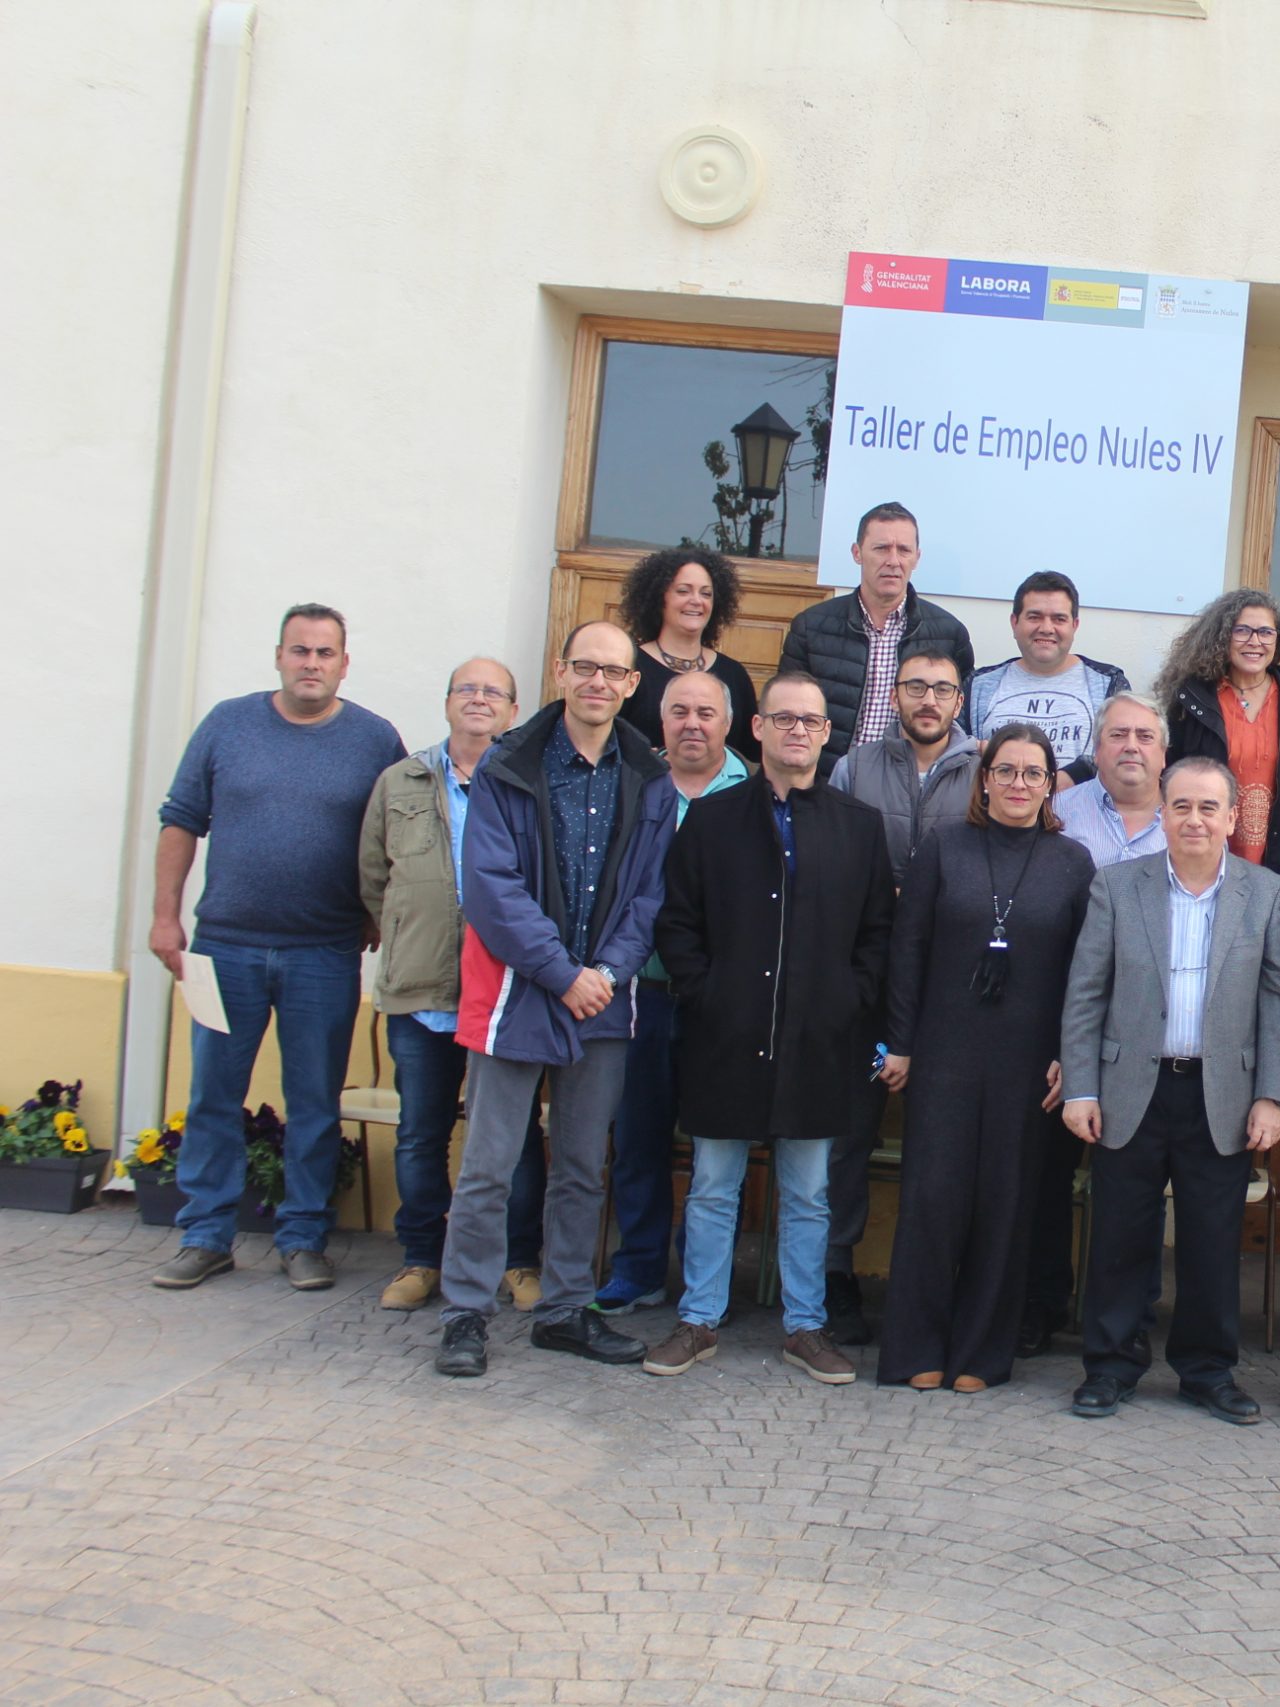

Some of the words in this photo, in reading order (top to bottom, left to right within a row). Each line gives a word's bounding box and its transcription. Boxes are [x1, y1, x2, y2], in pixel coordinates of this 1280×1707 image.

[876, 271, 932, 283] GENERALITAT
[961, 275, 1031, 293] LABORA
[876, 280, 930, 291] VALENCIANA
[845, 404, 925, 451] Taller
[933, 410, 968, 455] de
[978, 415, 1088, 471] Empleo
[1098, 424, 1182, 472] Nules
[1192, 433, 1224, 475] IV
[1026, 699, 1056, 714] NY
